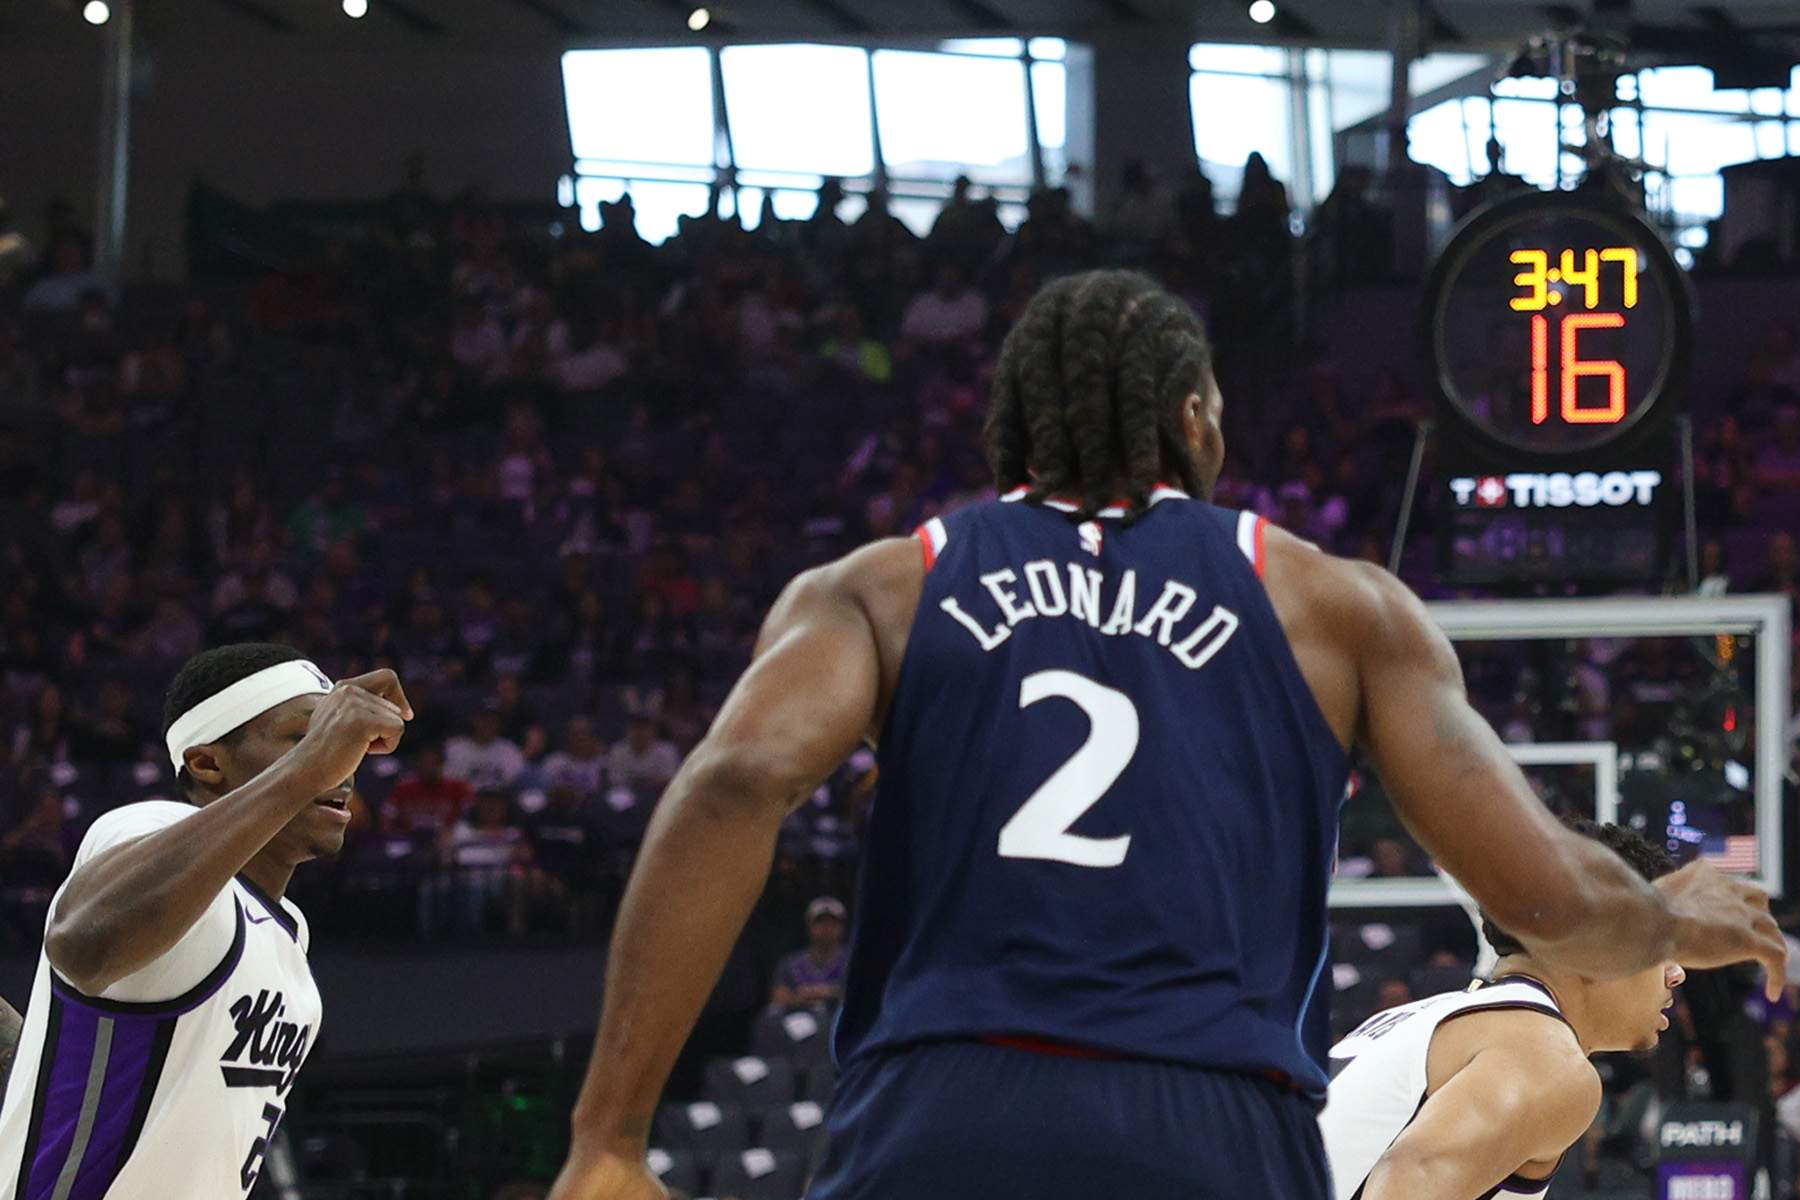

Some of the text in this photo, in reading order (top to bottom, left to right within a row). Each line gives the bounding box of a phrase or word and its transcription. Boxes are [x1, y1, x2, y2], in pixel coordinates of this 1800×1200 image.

[1508, 247, 1639, 311] 3:47
[1530, 312, 1627, 425] 16
[1504, 470, 1661, 508] TISSOT
[939, 558, 1240, 670] LEONARD
[997, 669, 1140, 867] 2
[219, 988, 310, 1097] King
[1660, 1119, 1743, 1147] PATH
